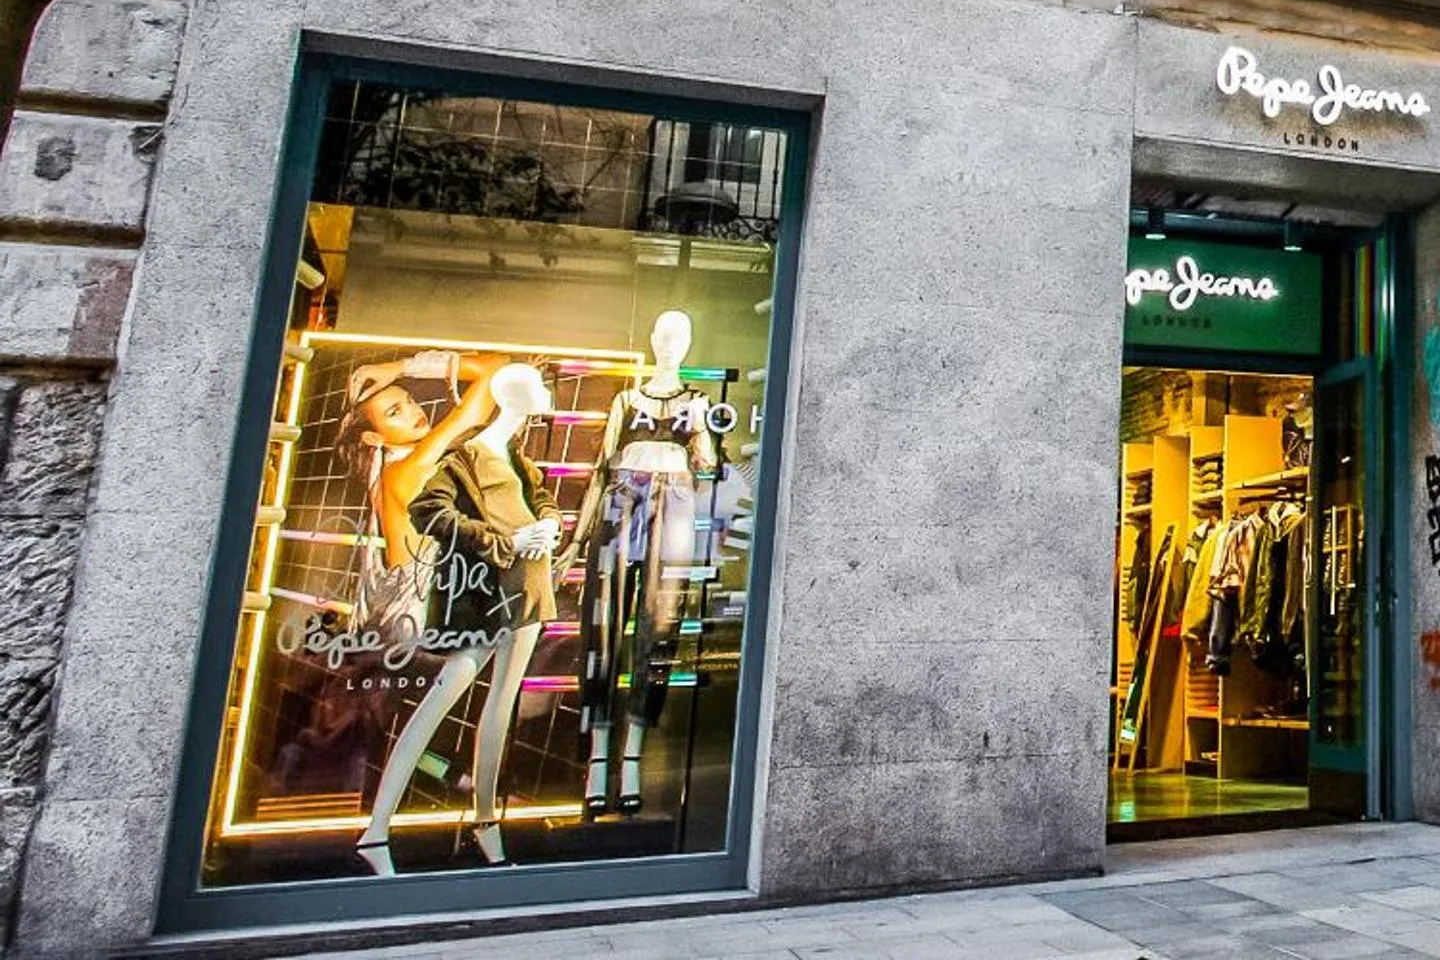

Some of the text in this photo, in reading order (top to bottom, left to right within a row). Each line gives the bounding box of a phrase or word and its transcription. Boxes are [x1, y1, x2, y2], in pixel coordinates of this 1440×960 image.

[1216, 46, 1431, 126] Pepe Jeans
[1283, 132, 1359, 151] LONDON
[1124, 255, 1280, 311] pe Jeans
[277, 610, 384, 670] Pepe
